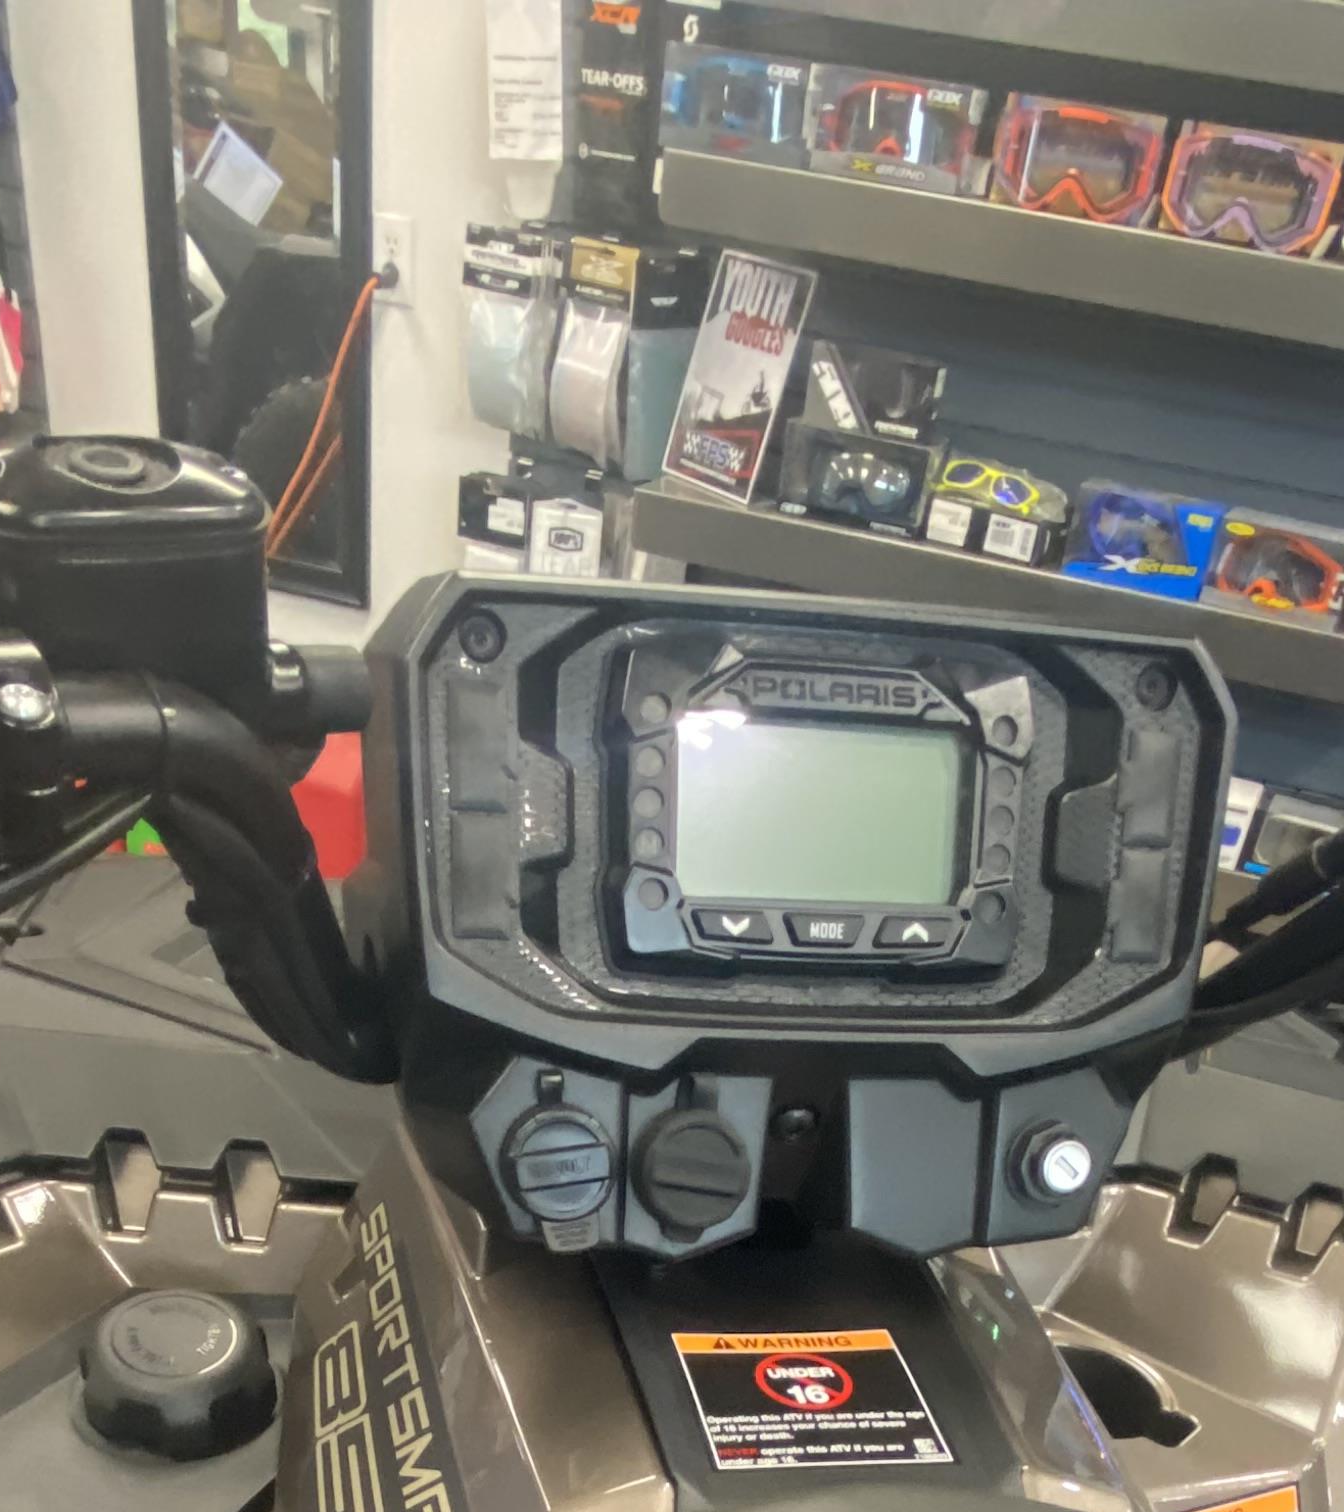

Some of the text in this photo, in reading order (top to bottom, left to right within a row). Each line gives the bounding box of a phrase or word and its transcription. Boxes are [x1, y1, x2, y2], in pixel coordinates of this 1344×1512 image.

[581, 67, 644, 93] TEAR-OFFS
[718, 257, 798, 329] YOUTH
[752, 675, 918, 709] POLARIS
[810, 921, 845, 940] MODE
[737, 1335, 853, 1350] WARNING
[766, 1366, 836, 1380] UNDER
[787, 1384, 831, 1405] 16
